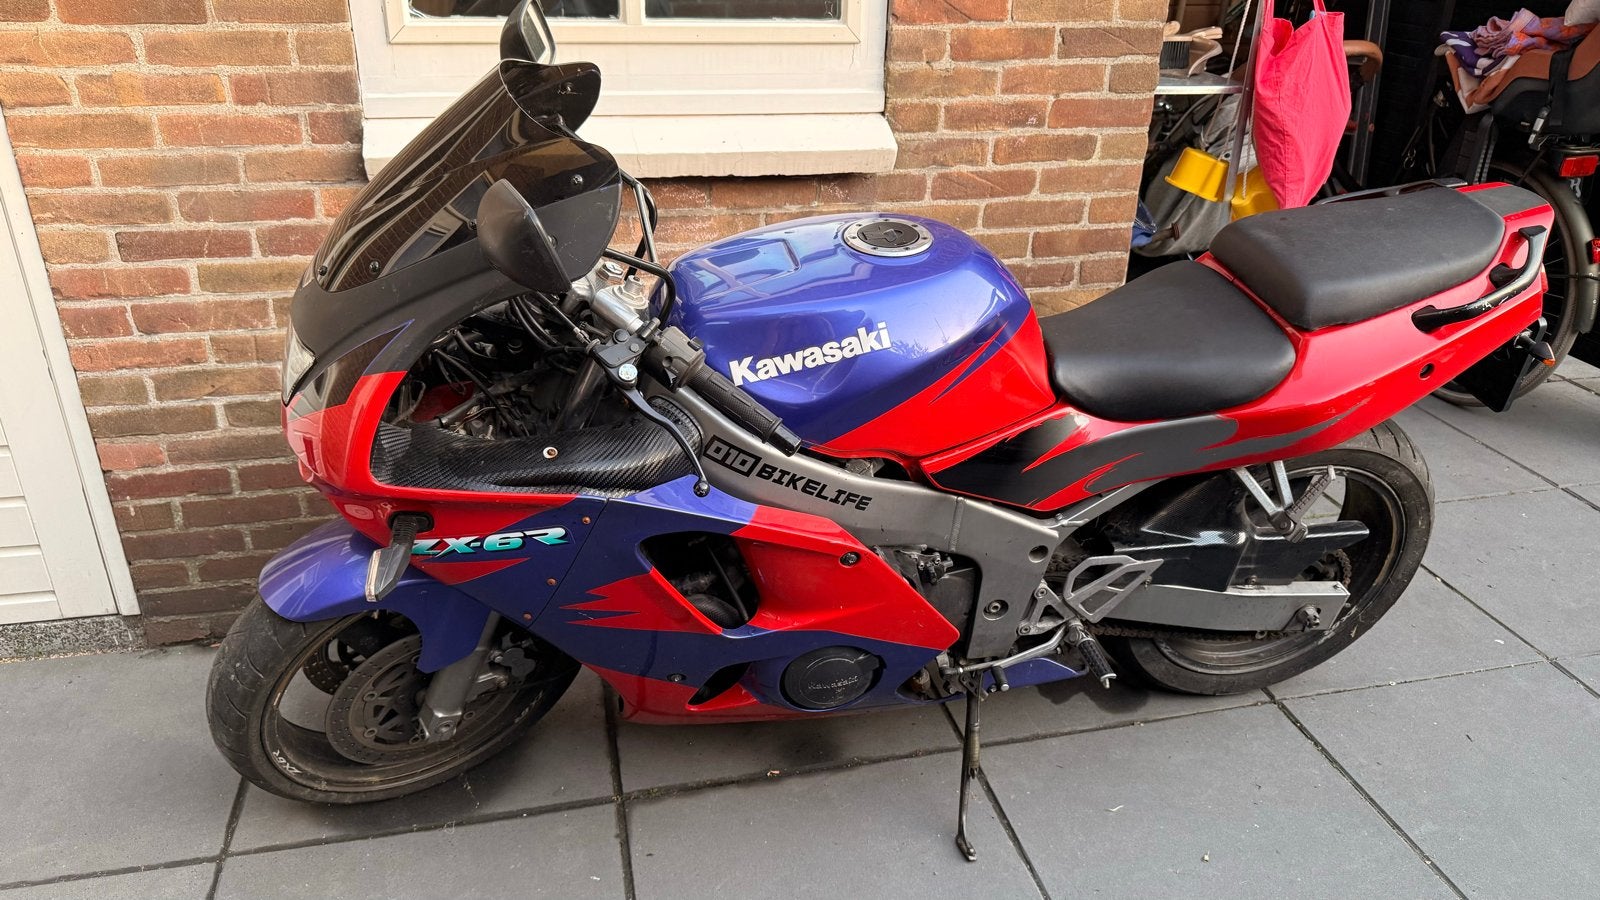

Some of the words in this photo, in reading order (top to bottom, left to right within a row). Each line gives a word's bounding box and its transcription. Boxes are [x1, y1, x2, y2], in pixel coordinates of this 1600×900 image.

[729, 321, 892, 387] Kawasaki
[755, 463, 873, 511] BIKELIFE
[411, 527, 569, 558] ZX-6R
